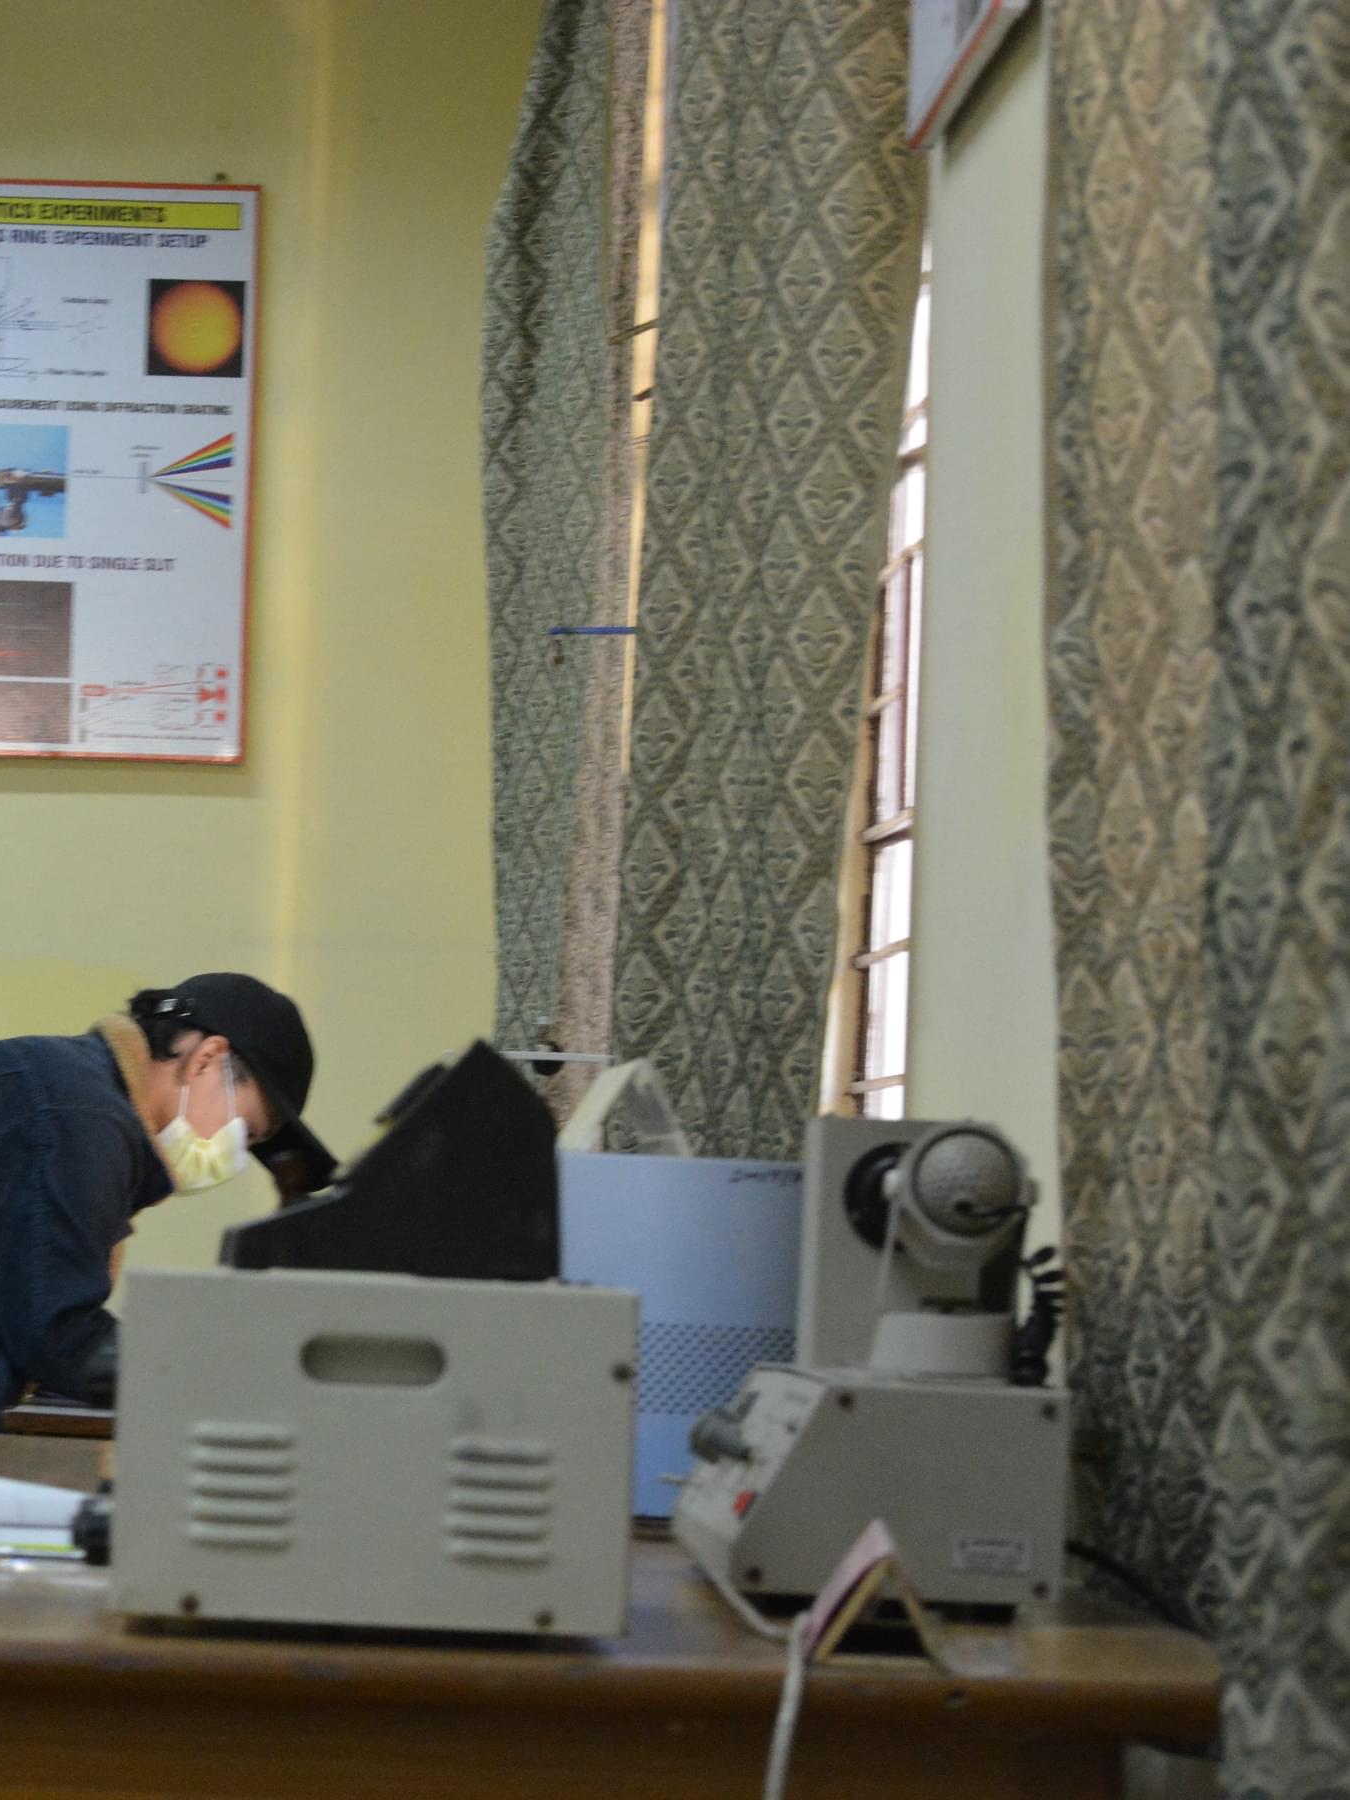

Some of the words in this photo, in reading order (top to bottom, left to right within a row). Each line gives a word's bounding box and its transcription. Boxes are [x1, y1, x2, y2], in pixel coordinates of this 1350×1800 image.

[38, 203, 167, 223] EXPERIMENTS
[10, 229, 47, 244] RING
[53, 231, 152, 247] EXPERIMENT
[157, 233, 210, 249] SETUP
[33, 554, 62, 569] DUE
[66, 555, 85, 569] TO
[88, 556, 141, 571] SINGLE
[144, 558, 176, 572] SLIT
